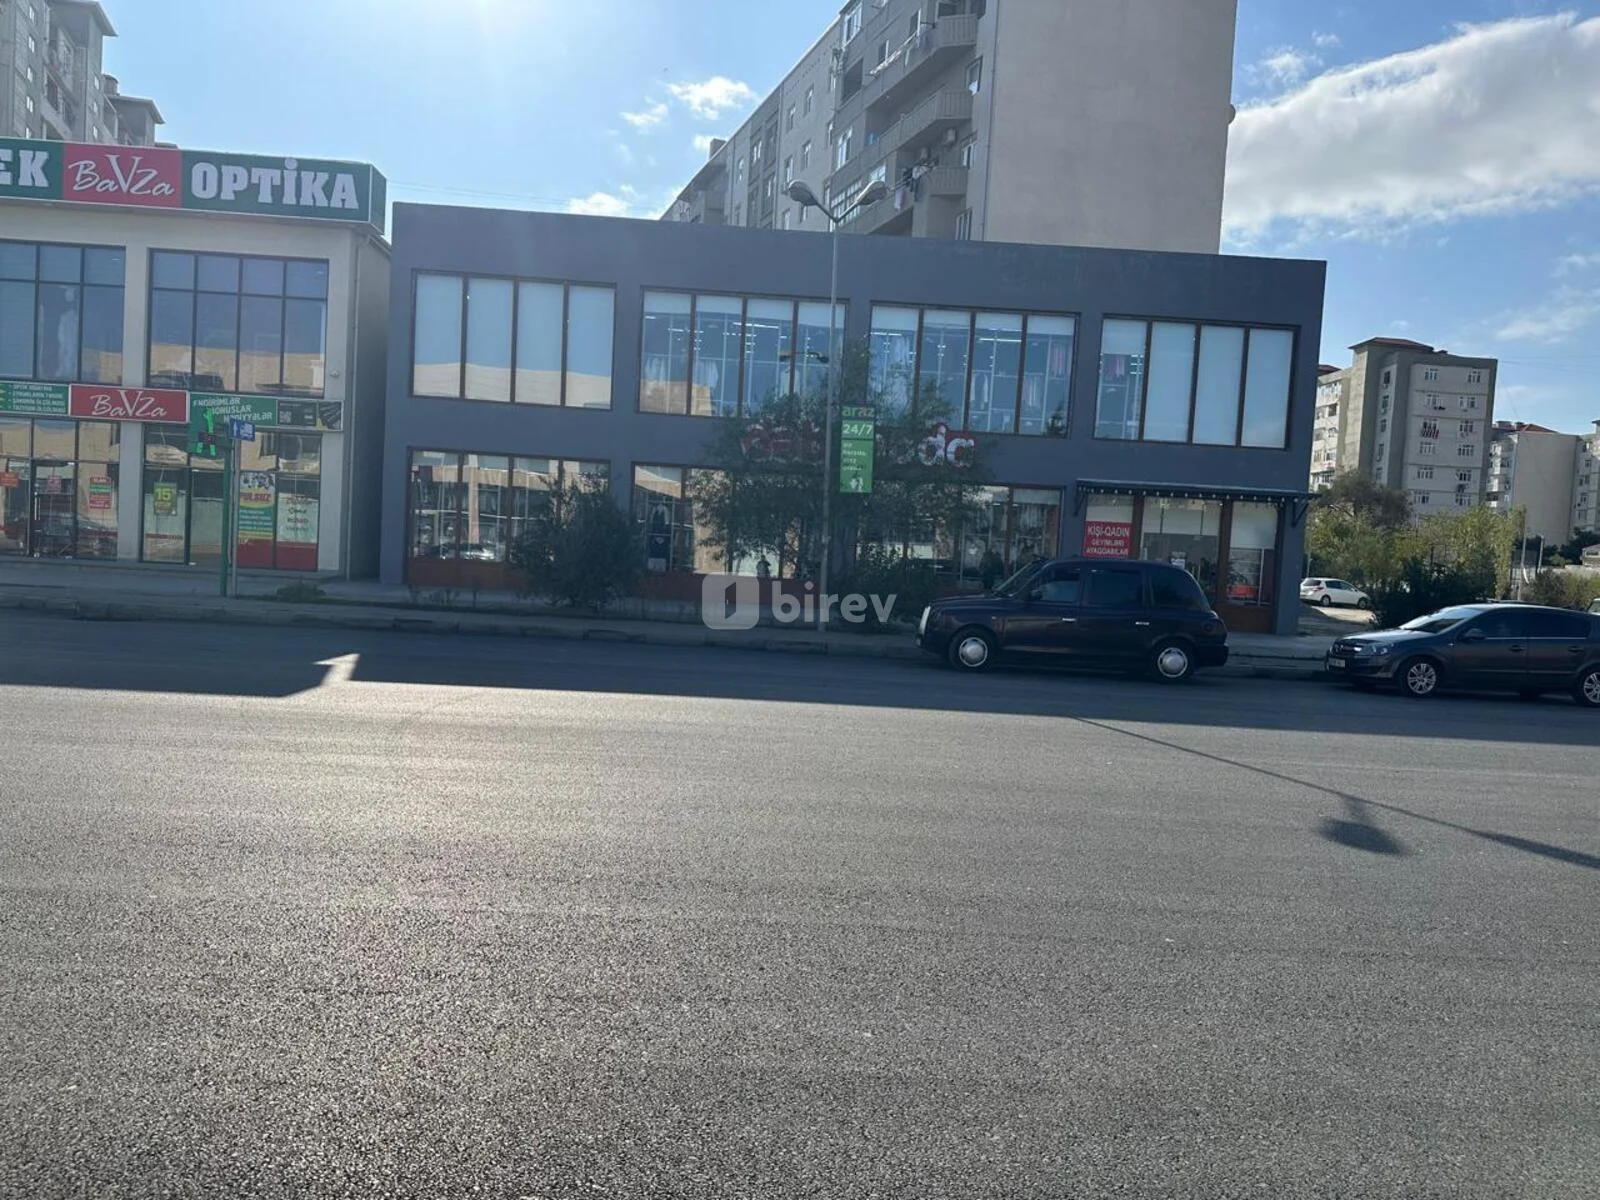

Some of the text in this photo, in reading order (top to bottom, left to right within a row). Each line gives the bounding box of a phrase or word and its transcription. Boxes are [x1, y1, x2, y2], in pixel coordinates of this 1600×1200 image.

[191, 158, 359, 209] OPTİKA
[843, 424, 873, 436] 24/7
[1087, 523, 1130, 537] KİŞİ-QADIN
